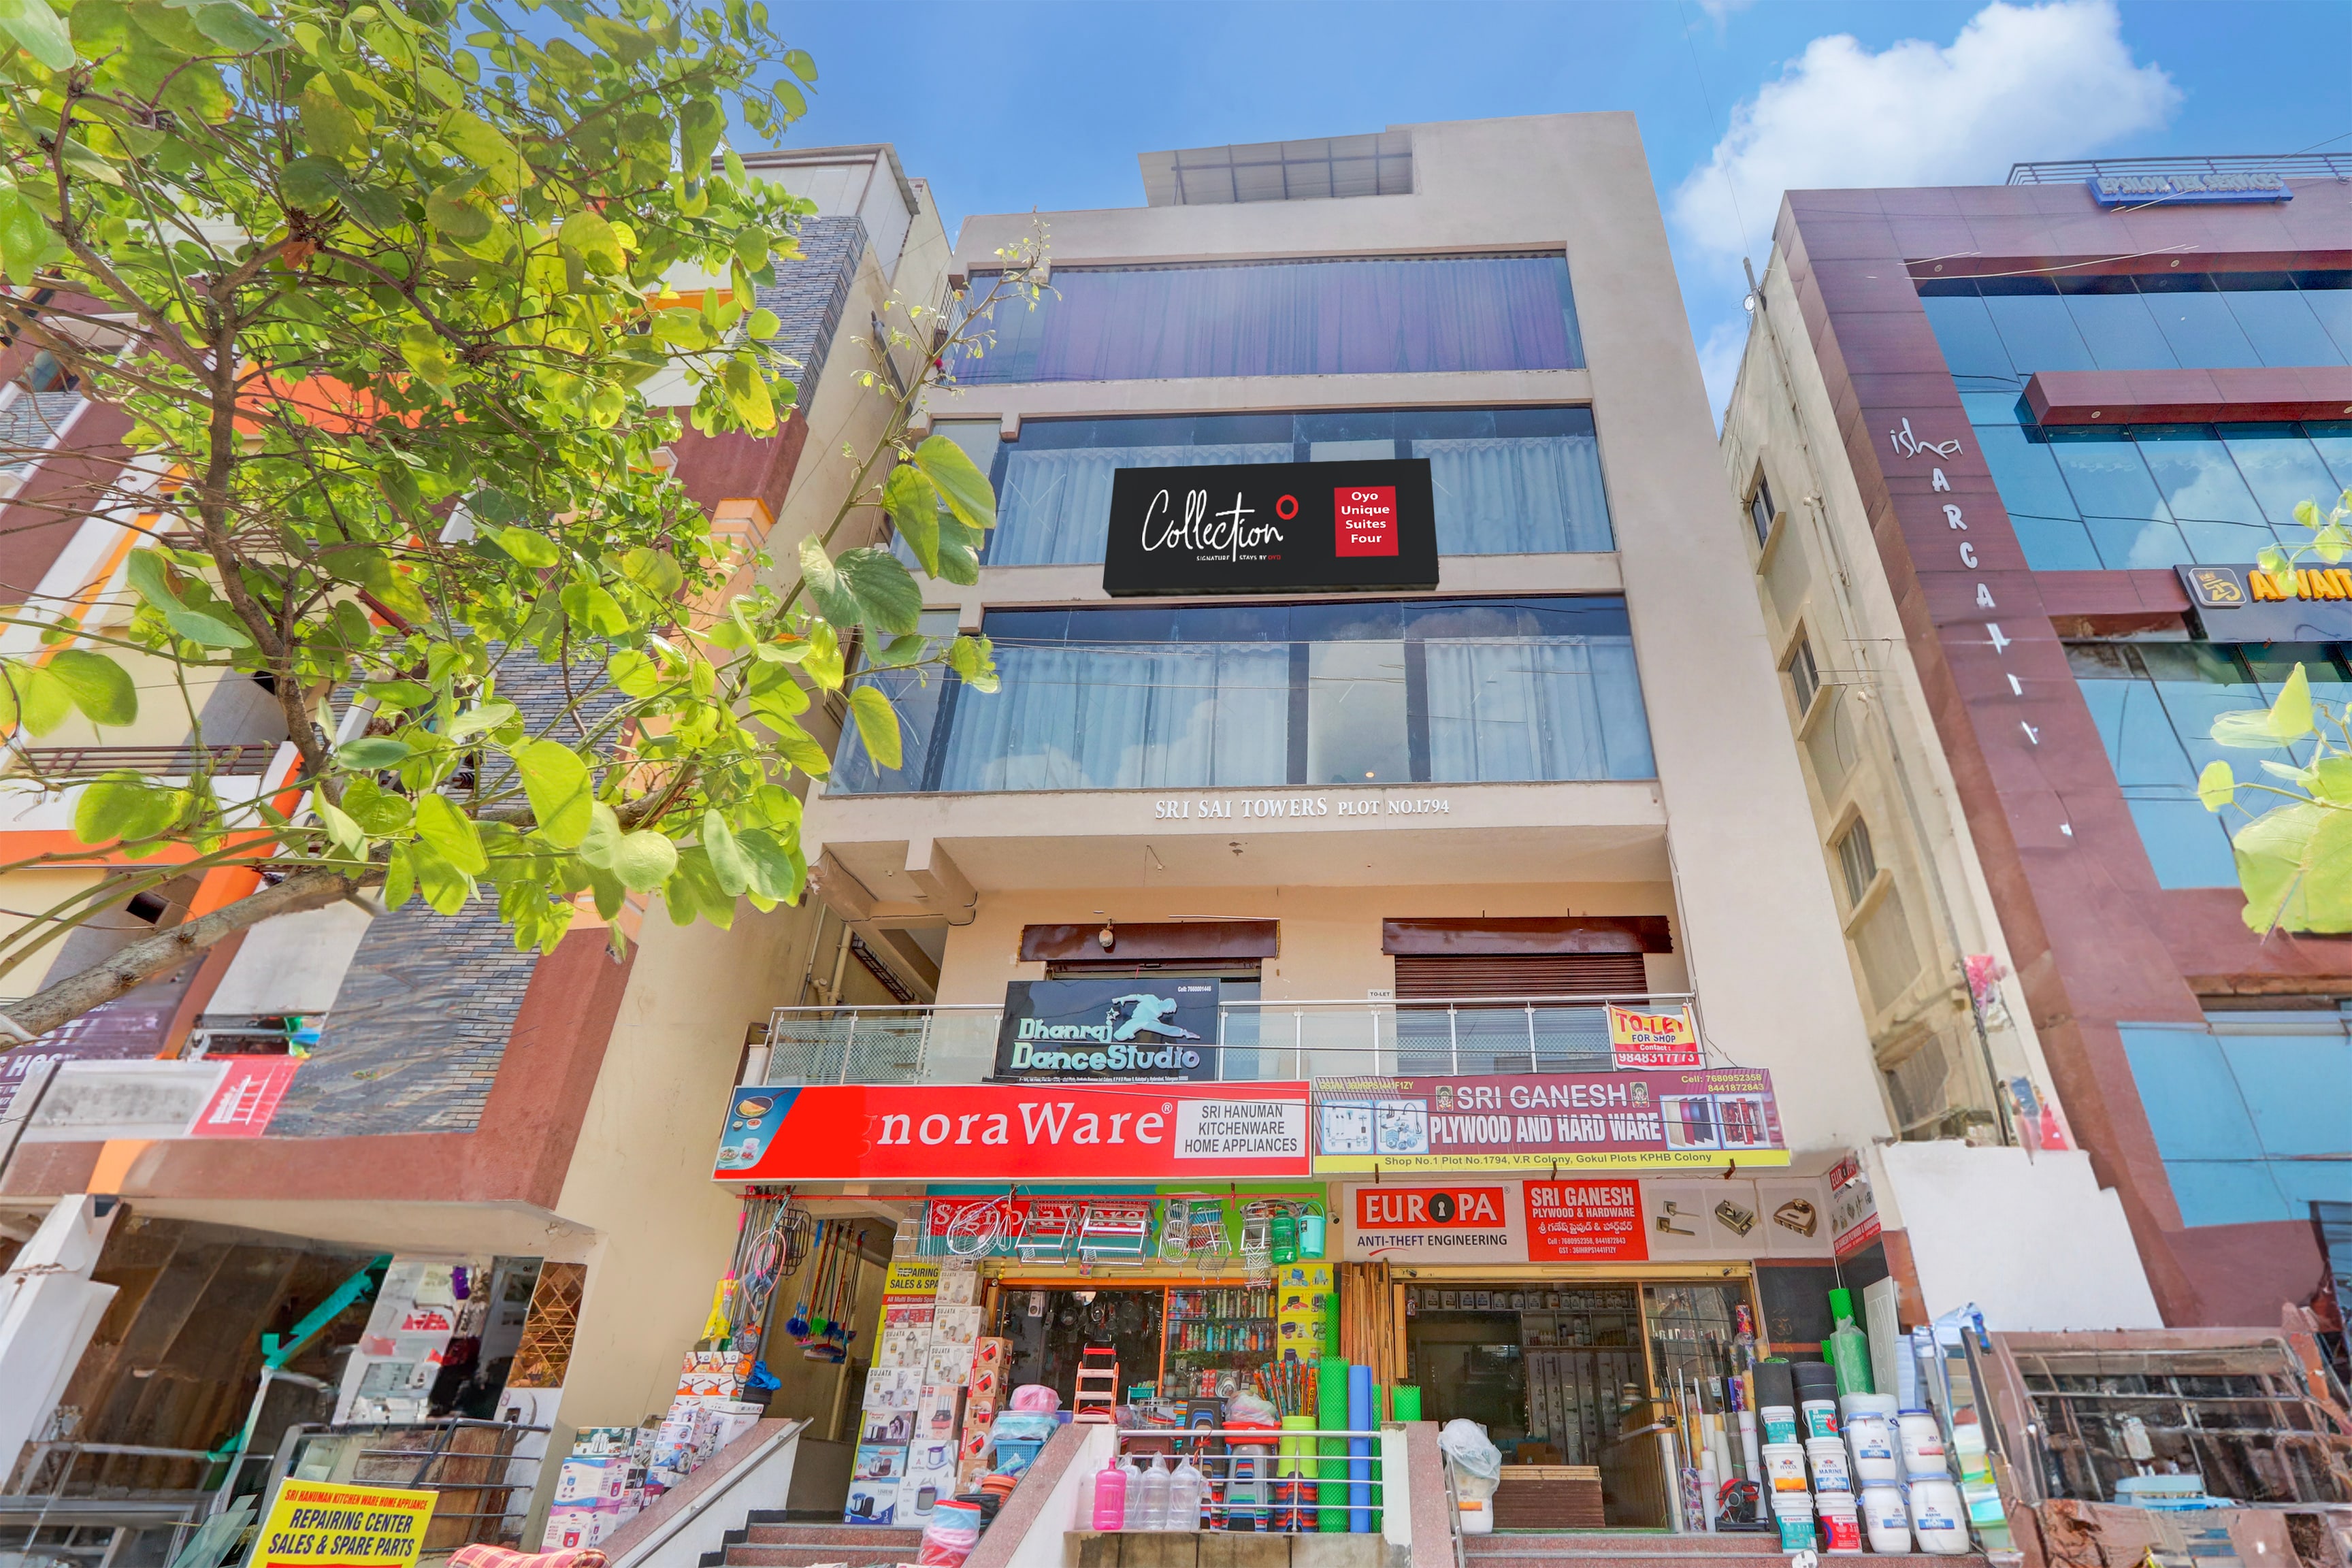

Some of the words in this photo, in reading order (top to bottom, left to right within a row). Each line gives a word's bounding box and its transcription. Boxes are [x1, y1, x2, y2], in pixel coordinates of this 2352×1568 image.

[1351, 491, 1378, 502] Oyo
[1341, 505, 1390, 516] Unique
[1142, 489, 1284, 562] Collection
[1345, 519, 1386, 529] Suites
[1351, 534, 1382, 544] Four
[1155, 800, 1190, 819] SRI
[1198, 800, 1232, 818] SAI
[1241, 798, 1327, 817] TOWERS
[1337, 800, 1380, 816] PLOT
[1018, 1018, 1114, 1043] Dhanraj
[1654, 1034, 1676, 1043] SHOP
[1681, 1075, 1703, 1083] Cell:
[1705, 1074, 1762, 1082] 7680952358
[1708, 1083, 1765, 1092] 8441872843
[1457, 1085, 1502, 1110] SRI
[1509, 1083, 1627, 1109] GANESH
[1201, 1105, 1222, 1119] SRI
[1224, 1105, 1283, 1118] HANUMAN
[1198, 1121, 1284, 1136] KITCHENWARE
[1431, 1115, 1512, 1144] PLYWOOD
[1516, 1113, 1553, 1143] AND
[1557, 1113, 1606, 1143] HARD
[1607, 1112, 1663, 1142] WARE
[1185, 1139, 1219, 1153] HOME
[1222, 1138, 1298, 1153] APPLIANCES
[1385, 1157, 1414, 1166] Shop
[1442, 1156, 1464, 1164] Plot
[1514, 1156, 1531, 1164] V.R
[1576, 1155, 1607, 1163] Gokul
[1610, 1154, 1637, 1163] Plots
[1640, 1154, 1671, 1162] KPHB
[1674, 1153, 1712, 1163] Colony
[1531, 1187, 1560, 1207] SRI
[1565, 1187, 1635, 1207] GANESH
[1533, 1207, 1574, 1218] PLYWOOD
[1577, 1208, 1583, 1218] &
[1586, 1207, 1635, 1218] HARDWARE
[1357, 1235, 1424, 1247] ANTI-THEFT
[1428, 1235, 1507, 1245] ENGINEERING
[889, 1279, 915, 1288] SALES
[917, 1279, 922, 1288] &
[924, 1279, 938, 1288] SPA
[870, 1369, 892, 1377] SUJATA
[284, 1489, 297, 1501] SRI
[299, 1491, 331, 1503] HANUMAN
[333, 1492, 361, 1505] KITCHEN
[361, 1495, 379, 1506] WARE
[379, 1497, 396, 1508] HOME
[397, 1499, 427, 1509] APPLIANCE
[289, 1508, 364, 1531] REPAIRING
[365, 1512, 414, 1533] CENTER
[268, 1533, 315, 1554] SALES
[316, 1535, 327, 1555] &
[330, 1535, 375, 1556] SPARE
[375, 1537, 414, 1556] PARTS
